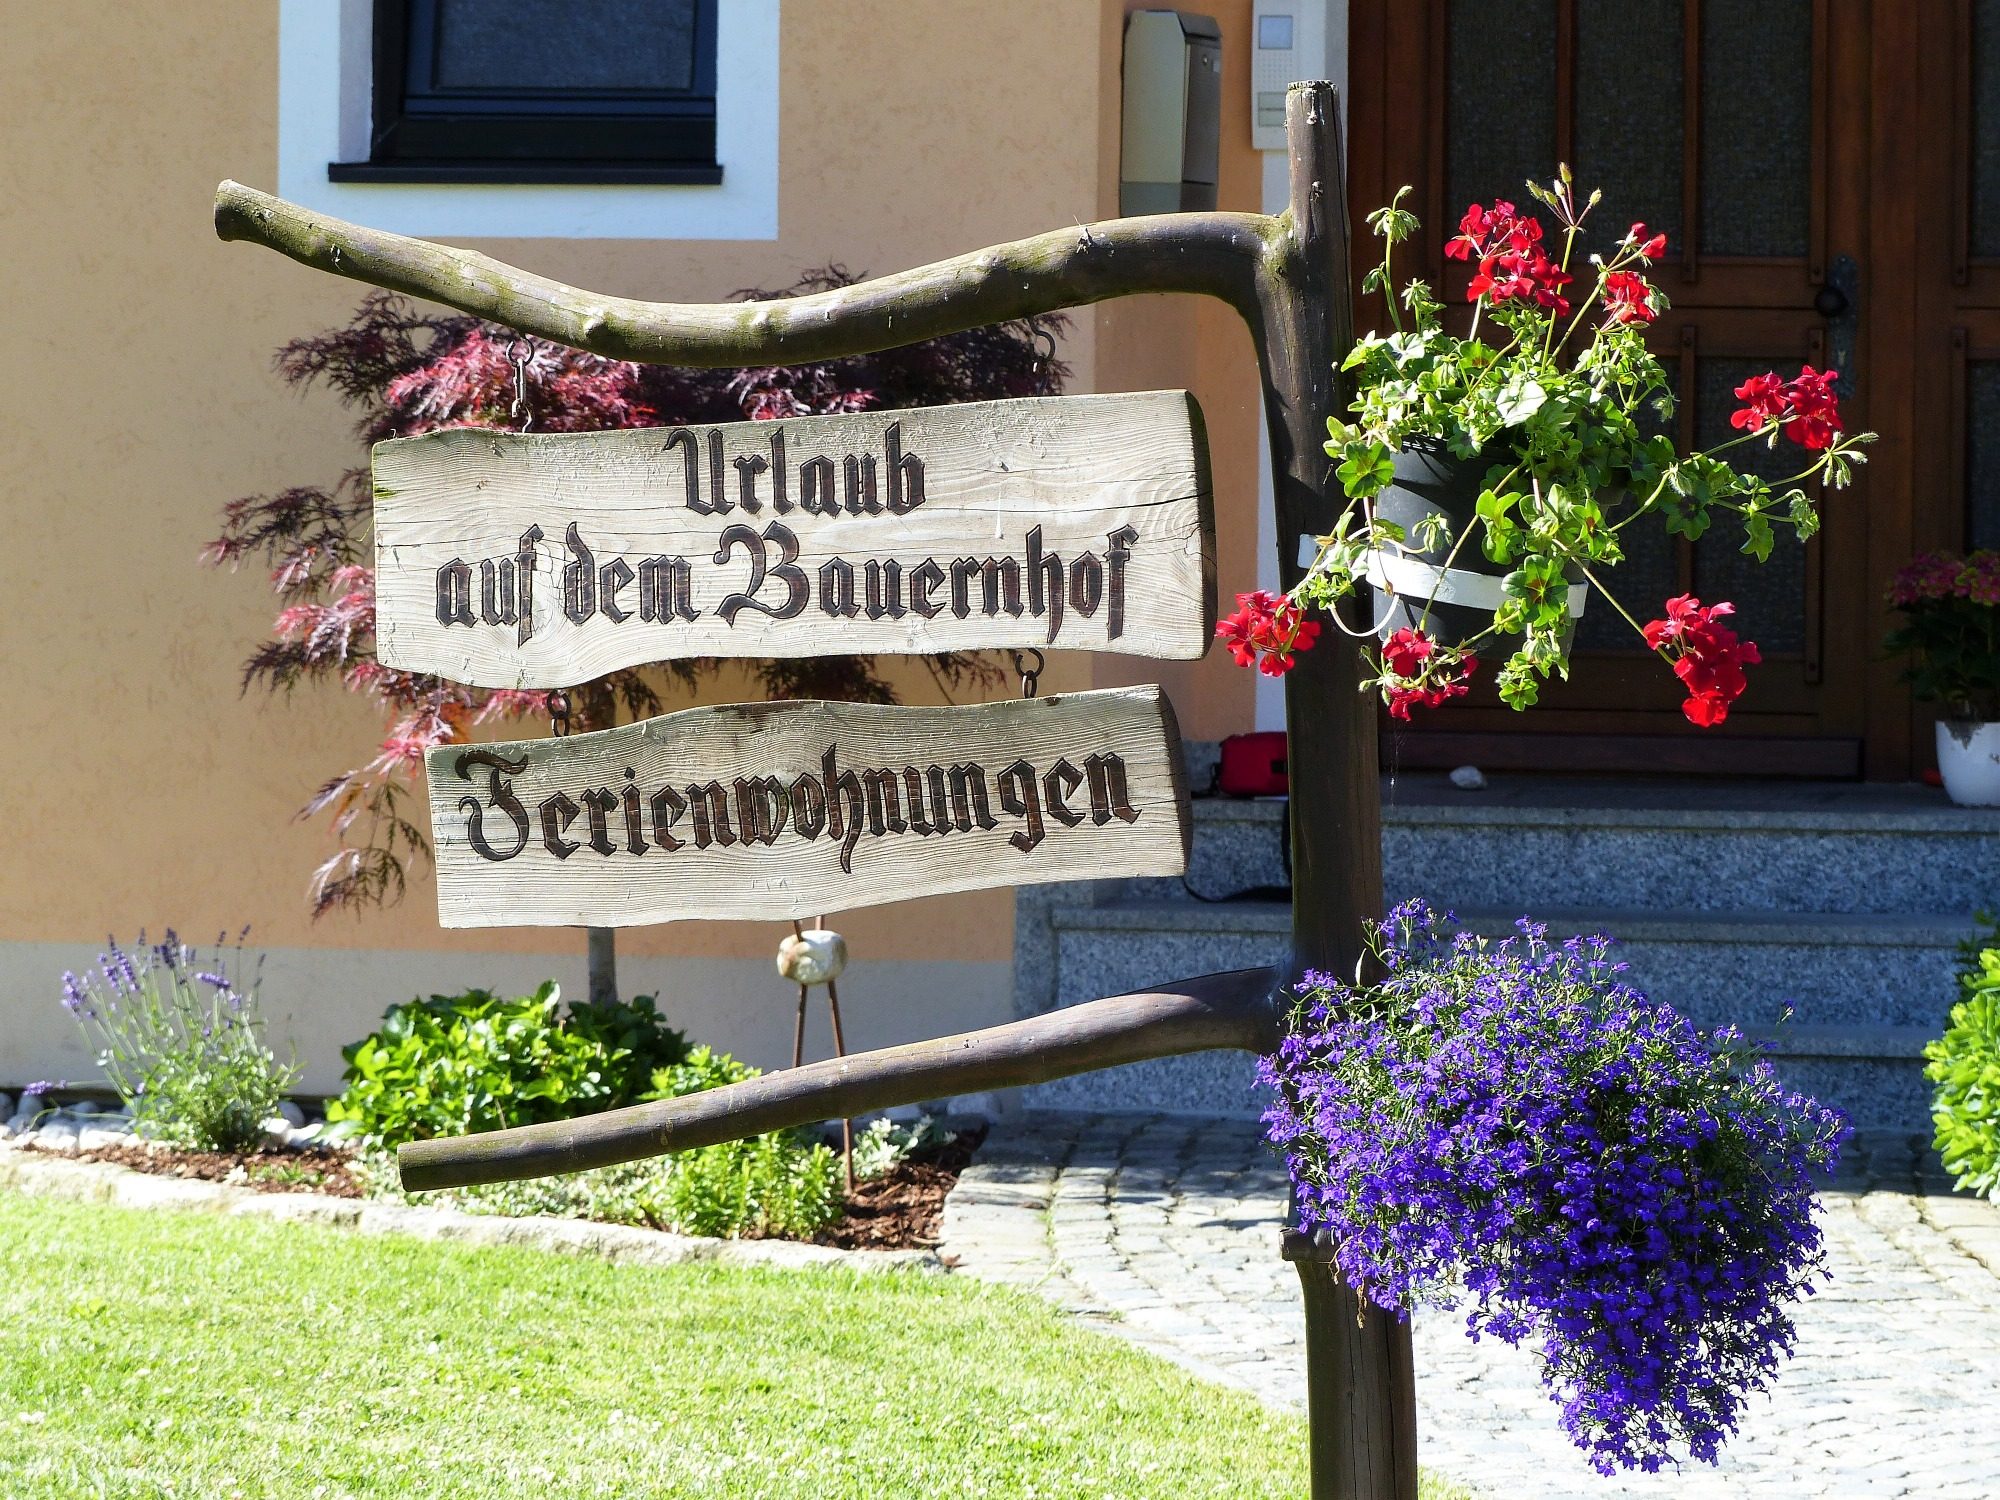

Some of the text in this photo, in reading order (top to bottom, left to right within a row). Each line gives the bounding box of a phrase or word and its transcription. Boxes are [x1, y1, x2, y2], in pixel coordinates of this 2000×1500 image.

[663, 420, 926, 518] Urlaub
[435, 520, 1140, 649] auf dem Bauernhof
[457, 742, 1143, 875] Ferienwohnungen
